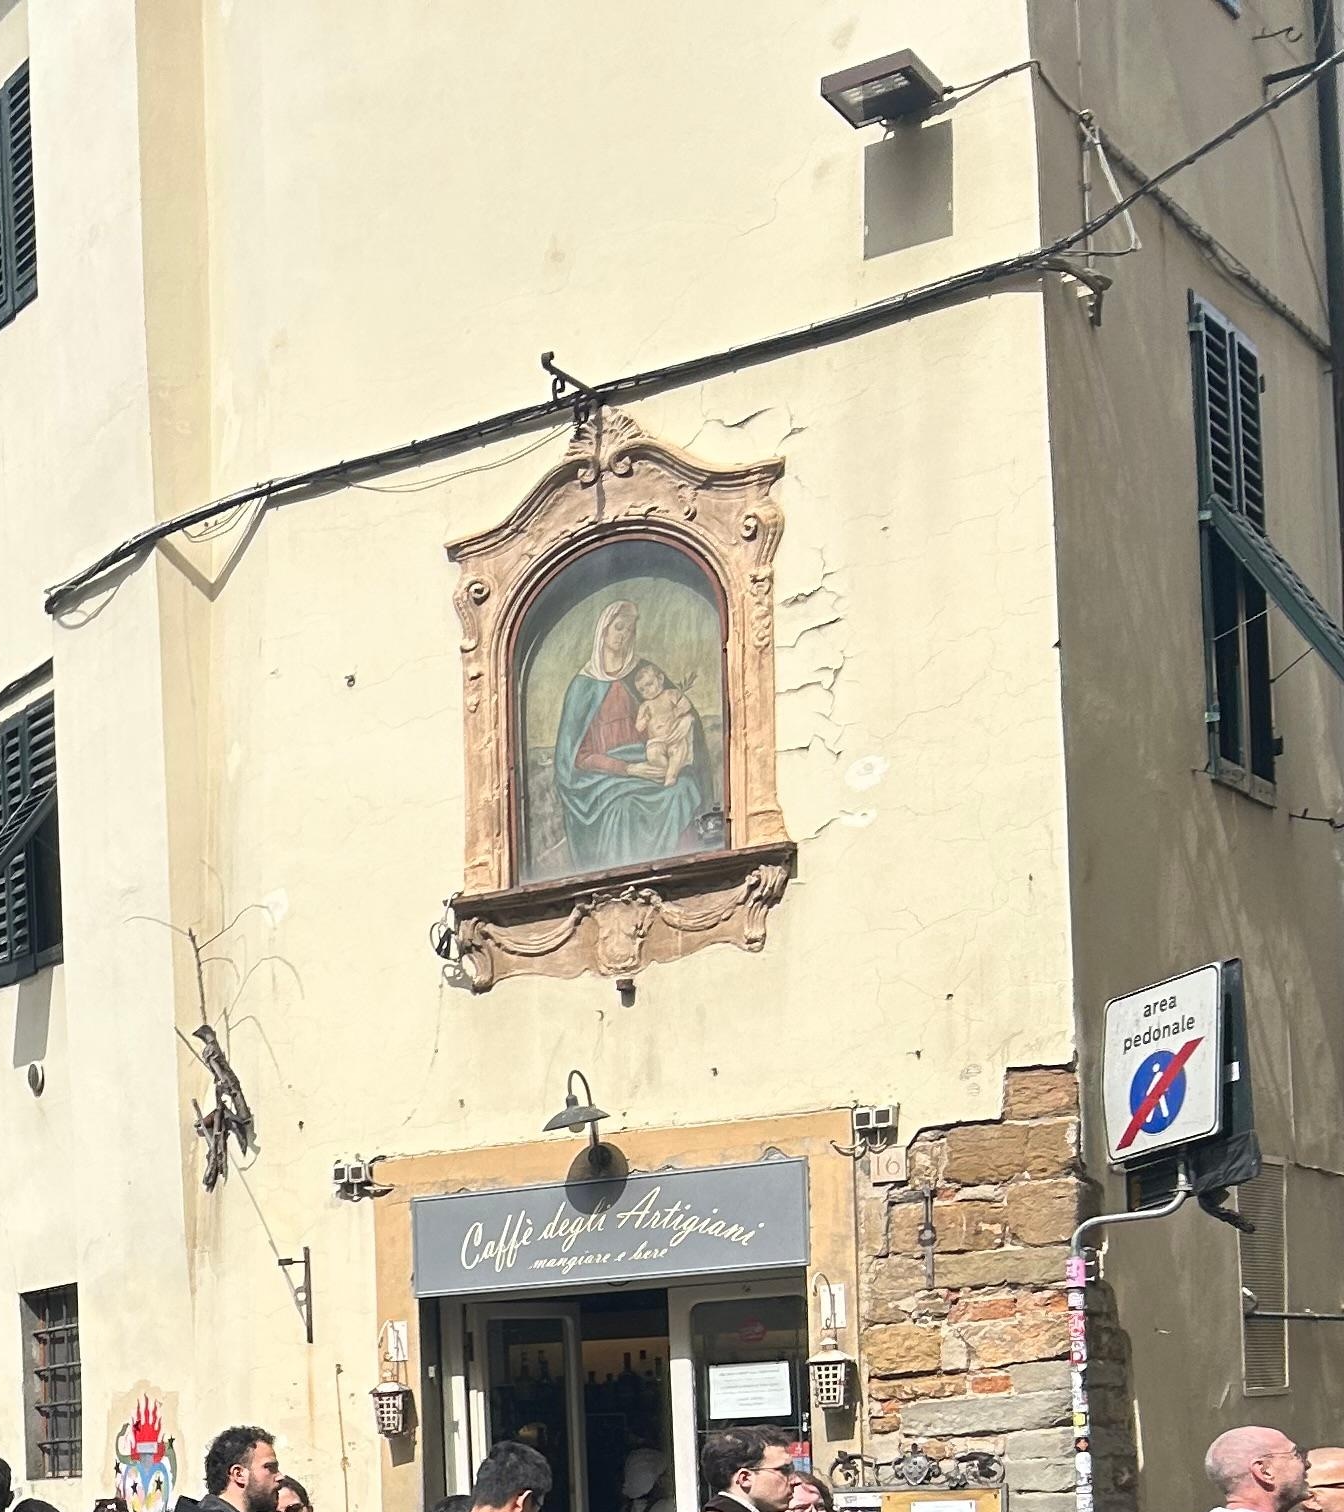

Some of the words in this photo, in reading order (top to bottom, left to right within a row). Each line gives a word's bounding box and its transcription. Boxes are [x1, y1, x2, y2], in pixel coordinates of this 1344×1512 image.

[1143, 993, 1177, 1018] area
[1122, 1014, 1196, 1054] pedonale
[460, 1210, 532, 1273] Caffè
[537, 1197, 611, 1253] degli
[616, 1186, 765, 1248] Artigiani
[528, 1249, 611, 1275] mangiare
[629, 1241, 670, 1261] bere
